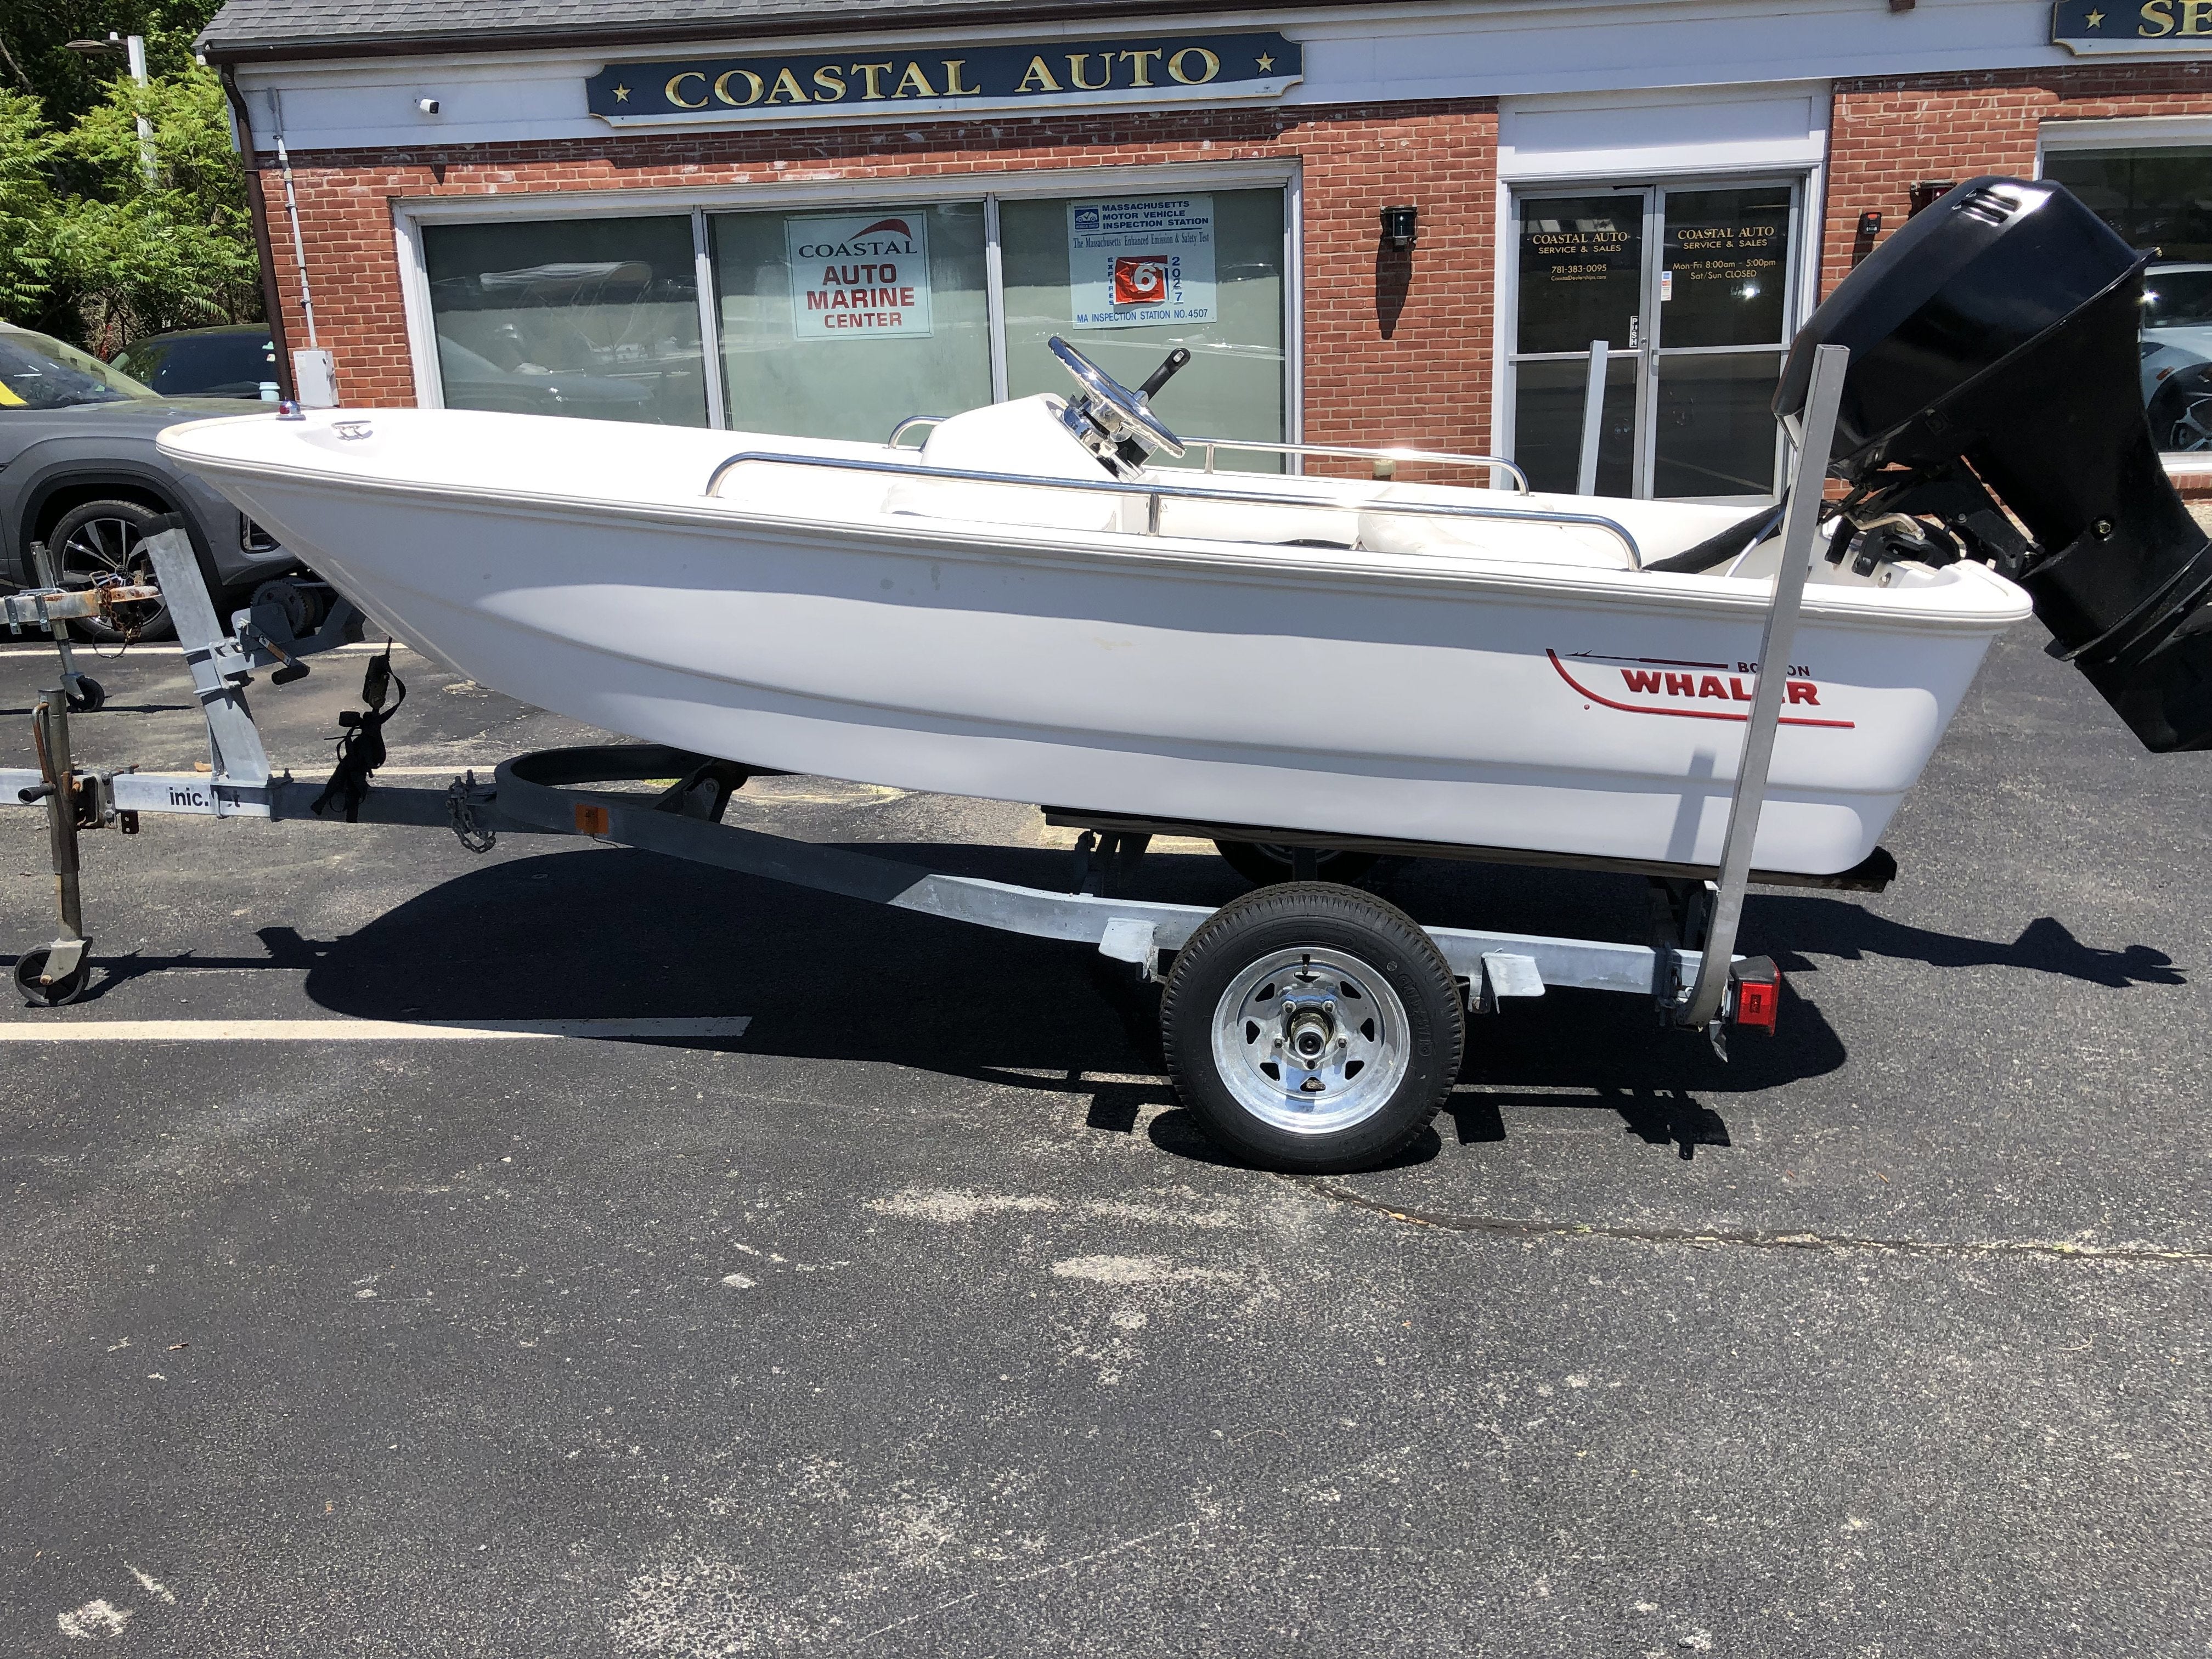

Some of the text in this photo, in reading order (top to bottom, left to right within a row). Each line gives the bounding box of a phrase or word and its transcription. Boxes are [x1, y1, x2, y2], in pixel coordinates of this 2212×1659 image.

[665, 47, 1220, 108] COASTAL AUTO
[1102, 201, 1189, 211] MASSACHUSETTS
[1103, 212, 1138, 221] MOTOR
[1103, 221, 1163, 229] INSPECTION
[1532, 232, 1628, 244] COASTAL AUTO
[1678, 226, 1774, 240] COASTAL AUTO
[1073, 232, 1209, 248] The Massachusetts Enhanced Emission & Safety Test
[1683, 241, 1722, 250] SERVICE
[1739, 239, 1768, 247] SALES
[798, 241, 918, 258] COASTAL
[1551, 264, 1607, 274] 781-383-0095
[1673, 261, 1702, 270] Mon-Fri
[1705, 260, 1735, 269] 8:00am
[1746, 258, 1776, 268] 5:00pm
[822, 263, 897, 286] AUTO
[1725, 269, 1757, 278] CLOSED
[806, 287, 915, 310] MARINE
[824, 312, 902, 329] CENTER
[1077, 314, 1088, 323] MA
[1092, 312, 1137, 321] INSPECTION
[1140, 311, 1170, 320] STATION
[1737, 662, 1810, 676] BOON
[1620, 669, 1821, 706] WHALR
